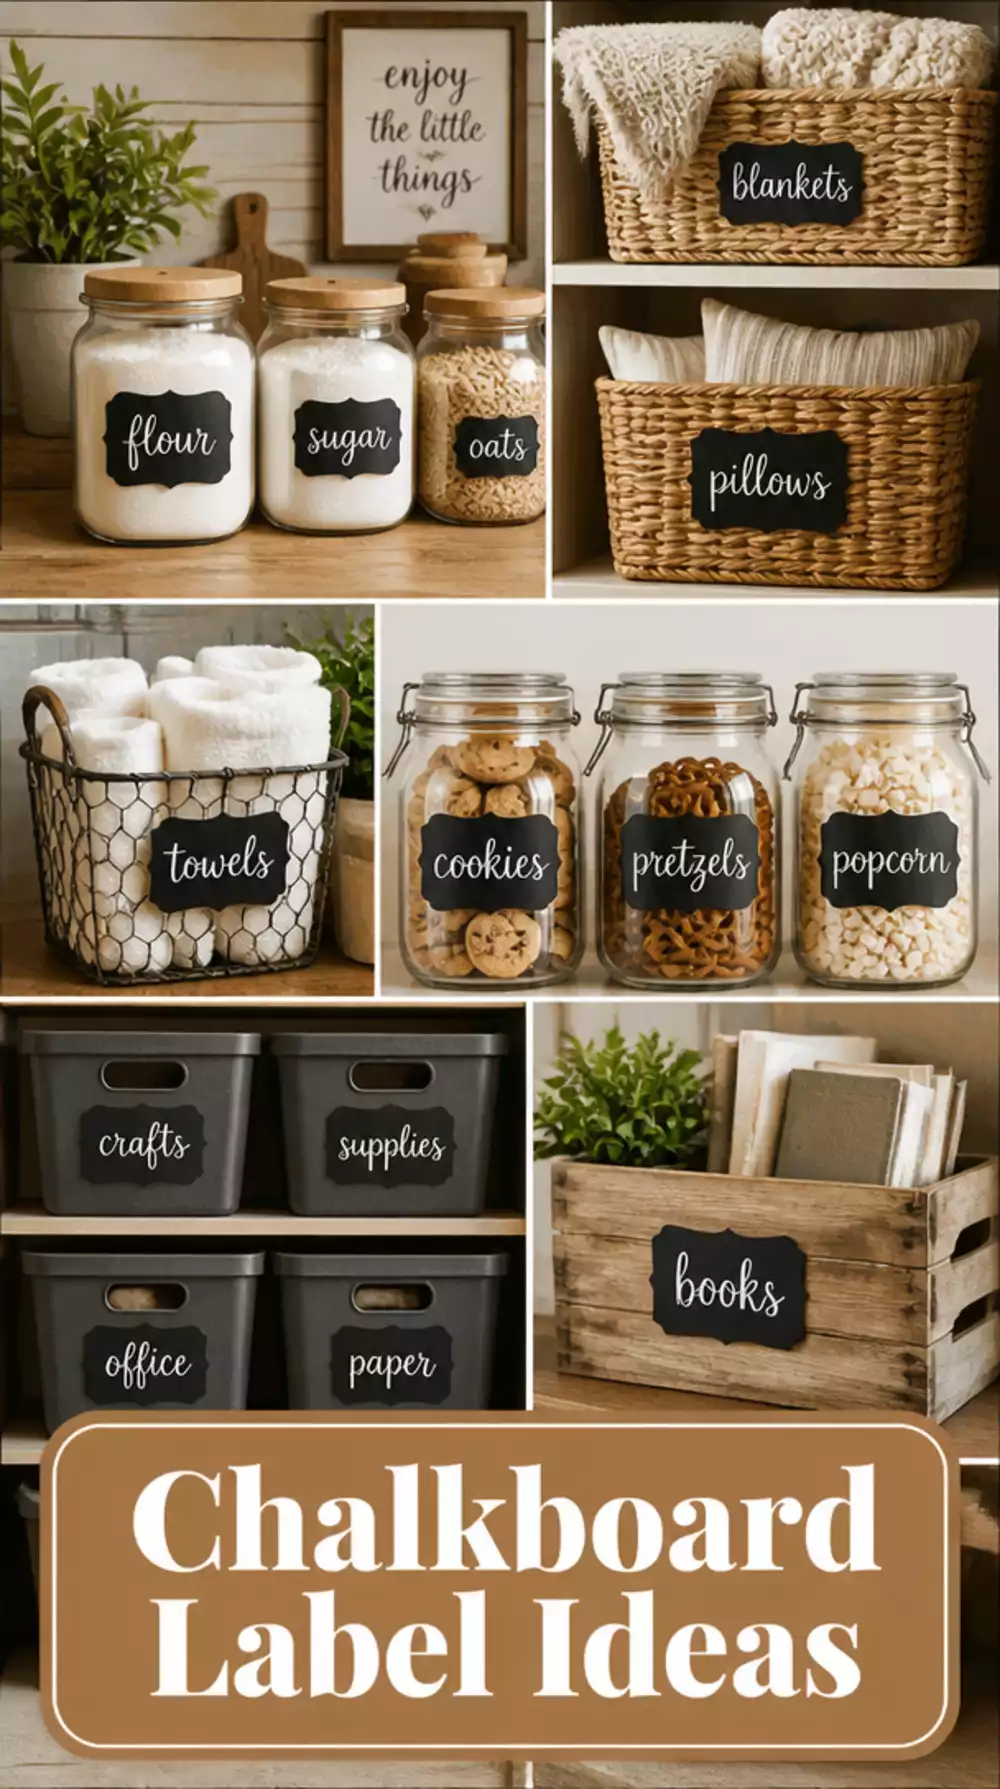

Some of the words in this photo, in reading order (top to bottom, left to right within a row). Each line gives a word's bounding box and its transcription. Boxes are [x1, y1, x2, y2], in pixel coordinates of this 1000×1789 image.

[383, 58, 470, 106] enjoy
[367, 109, 410, 143] the
[420, 109, 485, 143] little
[379, 154, 477, 209] things
[733, 162, 853, 203] blankets
[124, 414, 217, 471] flour
[306, 426, 392, 466] sugar
[469, 428, 529, 461] oats
[710, 453, 832, 512] pillows
[163, 834, 274, 883] towels
[433, 837, 550, 881] cookies
[633, 837, 752, 893] pretzels
[833, 847, 952, 890] popcorn
[99, 1121, 191, 1170] crafts
[339, 1124, 445, 1172] supplies
[675, 1251, 785, 1317] books
[105, 1341, 192, 1390] office
[349, 1352, 437, 1389] paper
